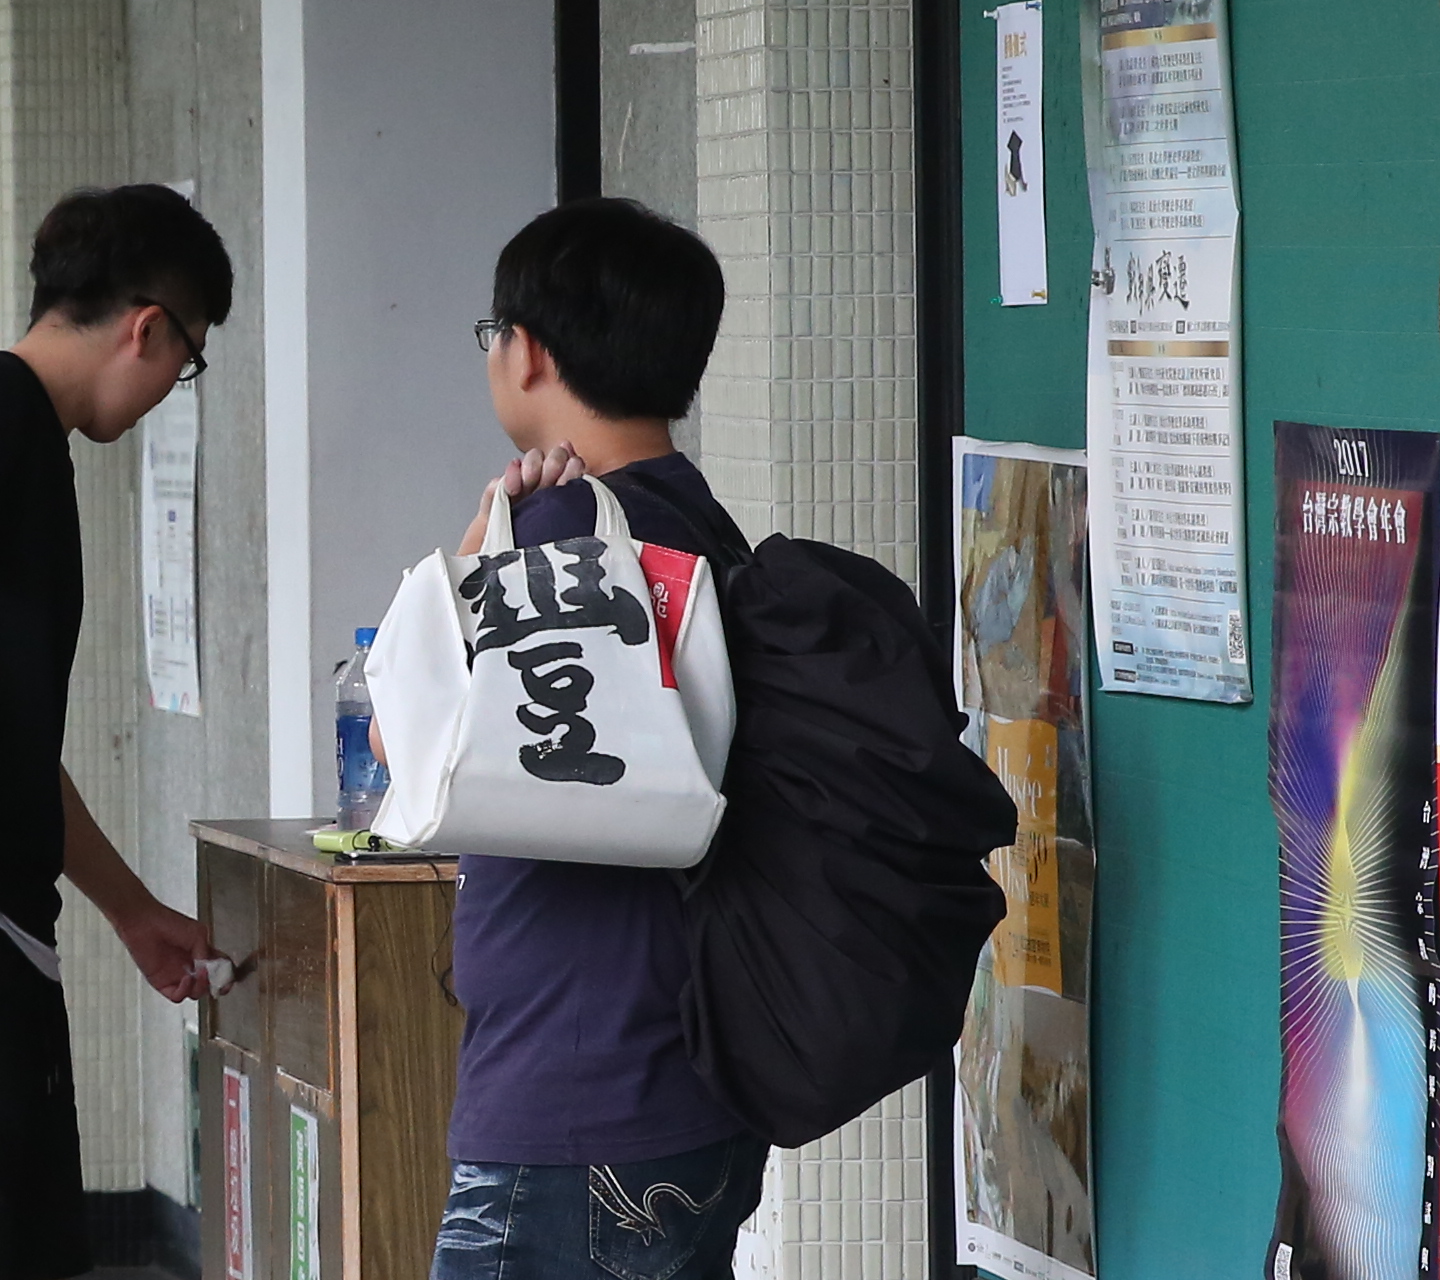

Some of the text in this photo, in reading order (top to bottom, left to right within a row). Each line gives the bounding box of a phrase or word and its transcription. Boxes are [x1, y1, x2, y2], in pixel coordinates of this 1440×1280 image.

[1333, 438, 1369, 478] 2017
[1303, 491, 1406, 544] 台灣宗教學會年會
